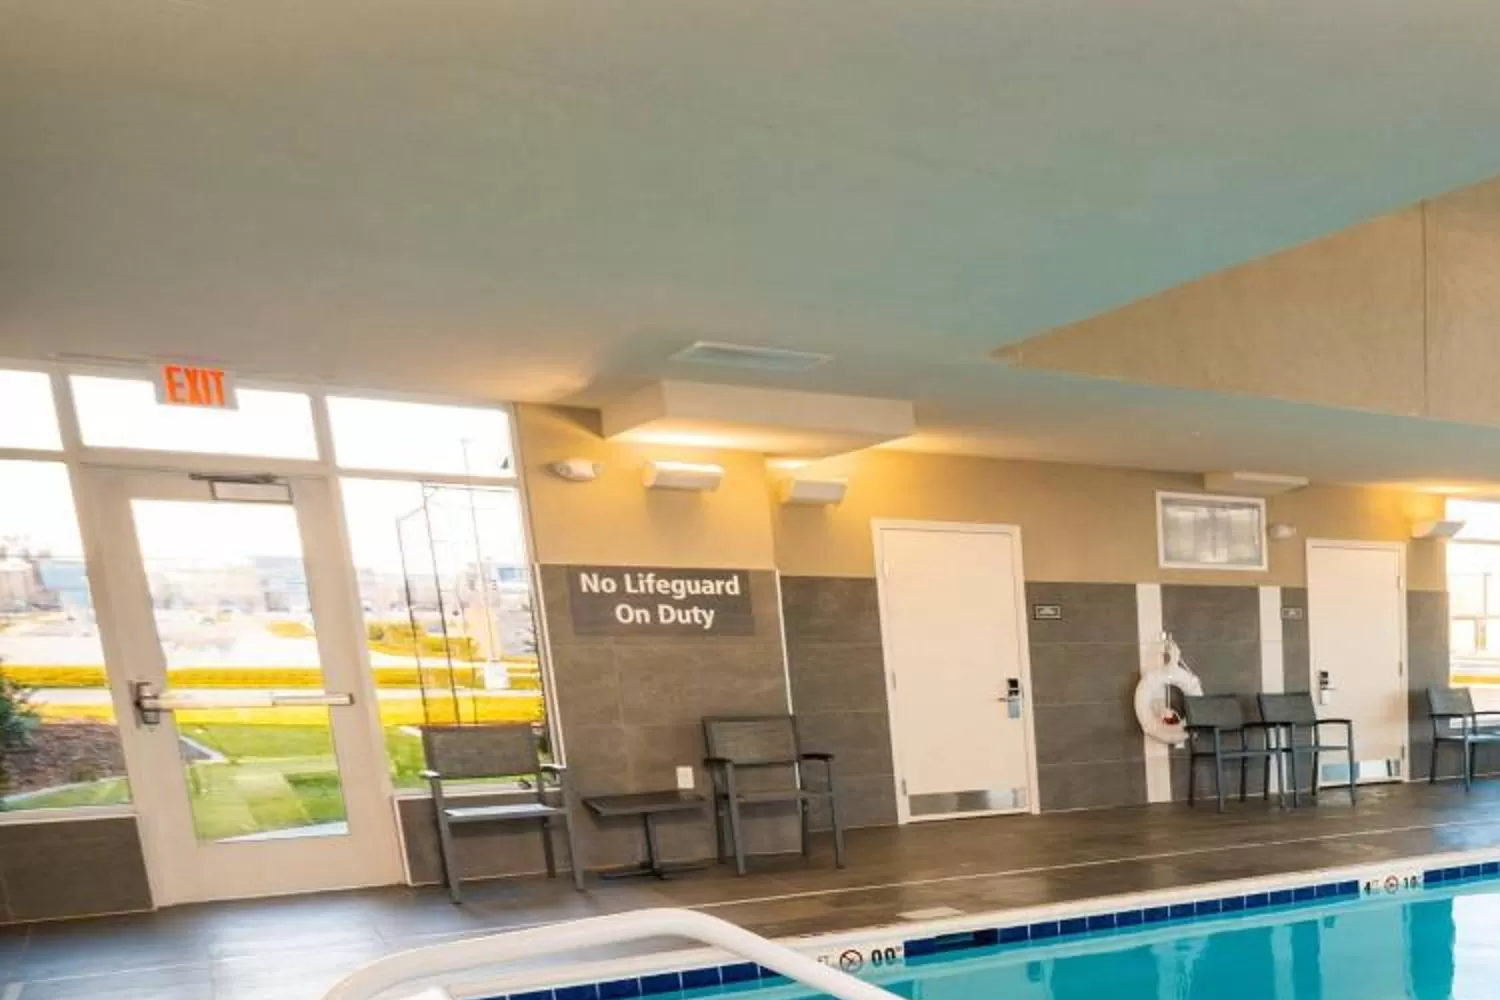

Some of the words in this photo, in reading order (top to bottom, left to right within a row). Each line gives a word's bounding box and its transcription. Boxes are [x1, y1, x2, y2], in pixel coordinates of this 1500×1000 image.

[164, 365, 225, 406] EXIT
[580, 573, 617, 593] No
[624, 573, 741, 599] Lifeguard
[615, 604, 650, 624] On
[657, 604, 715, 629] Duty
